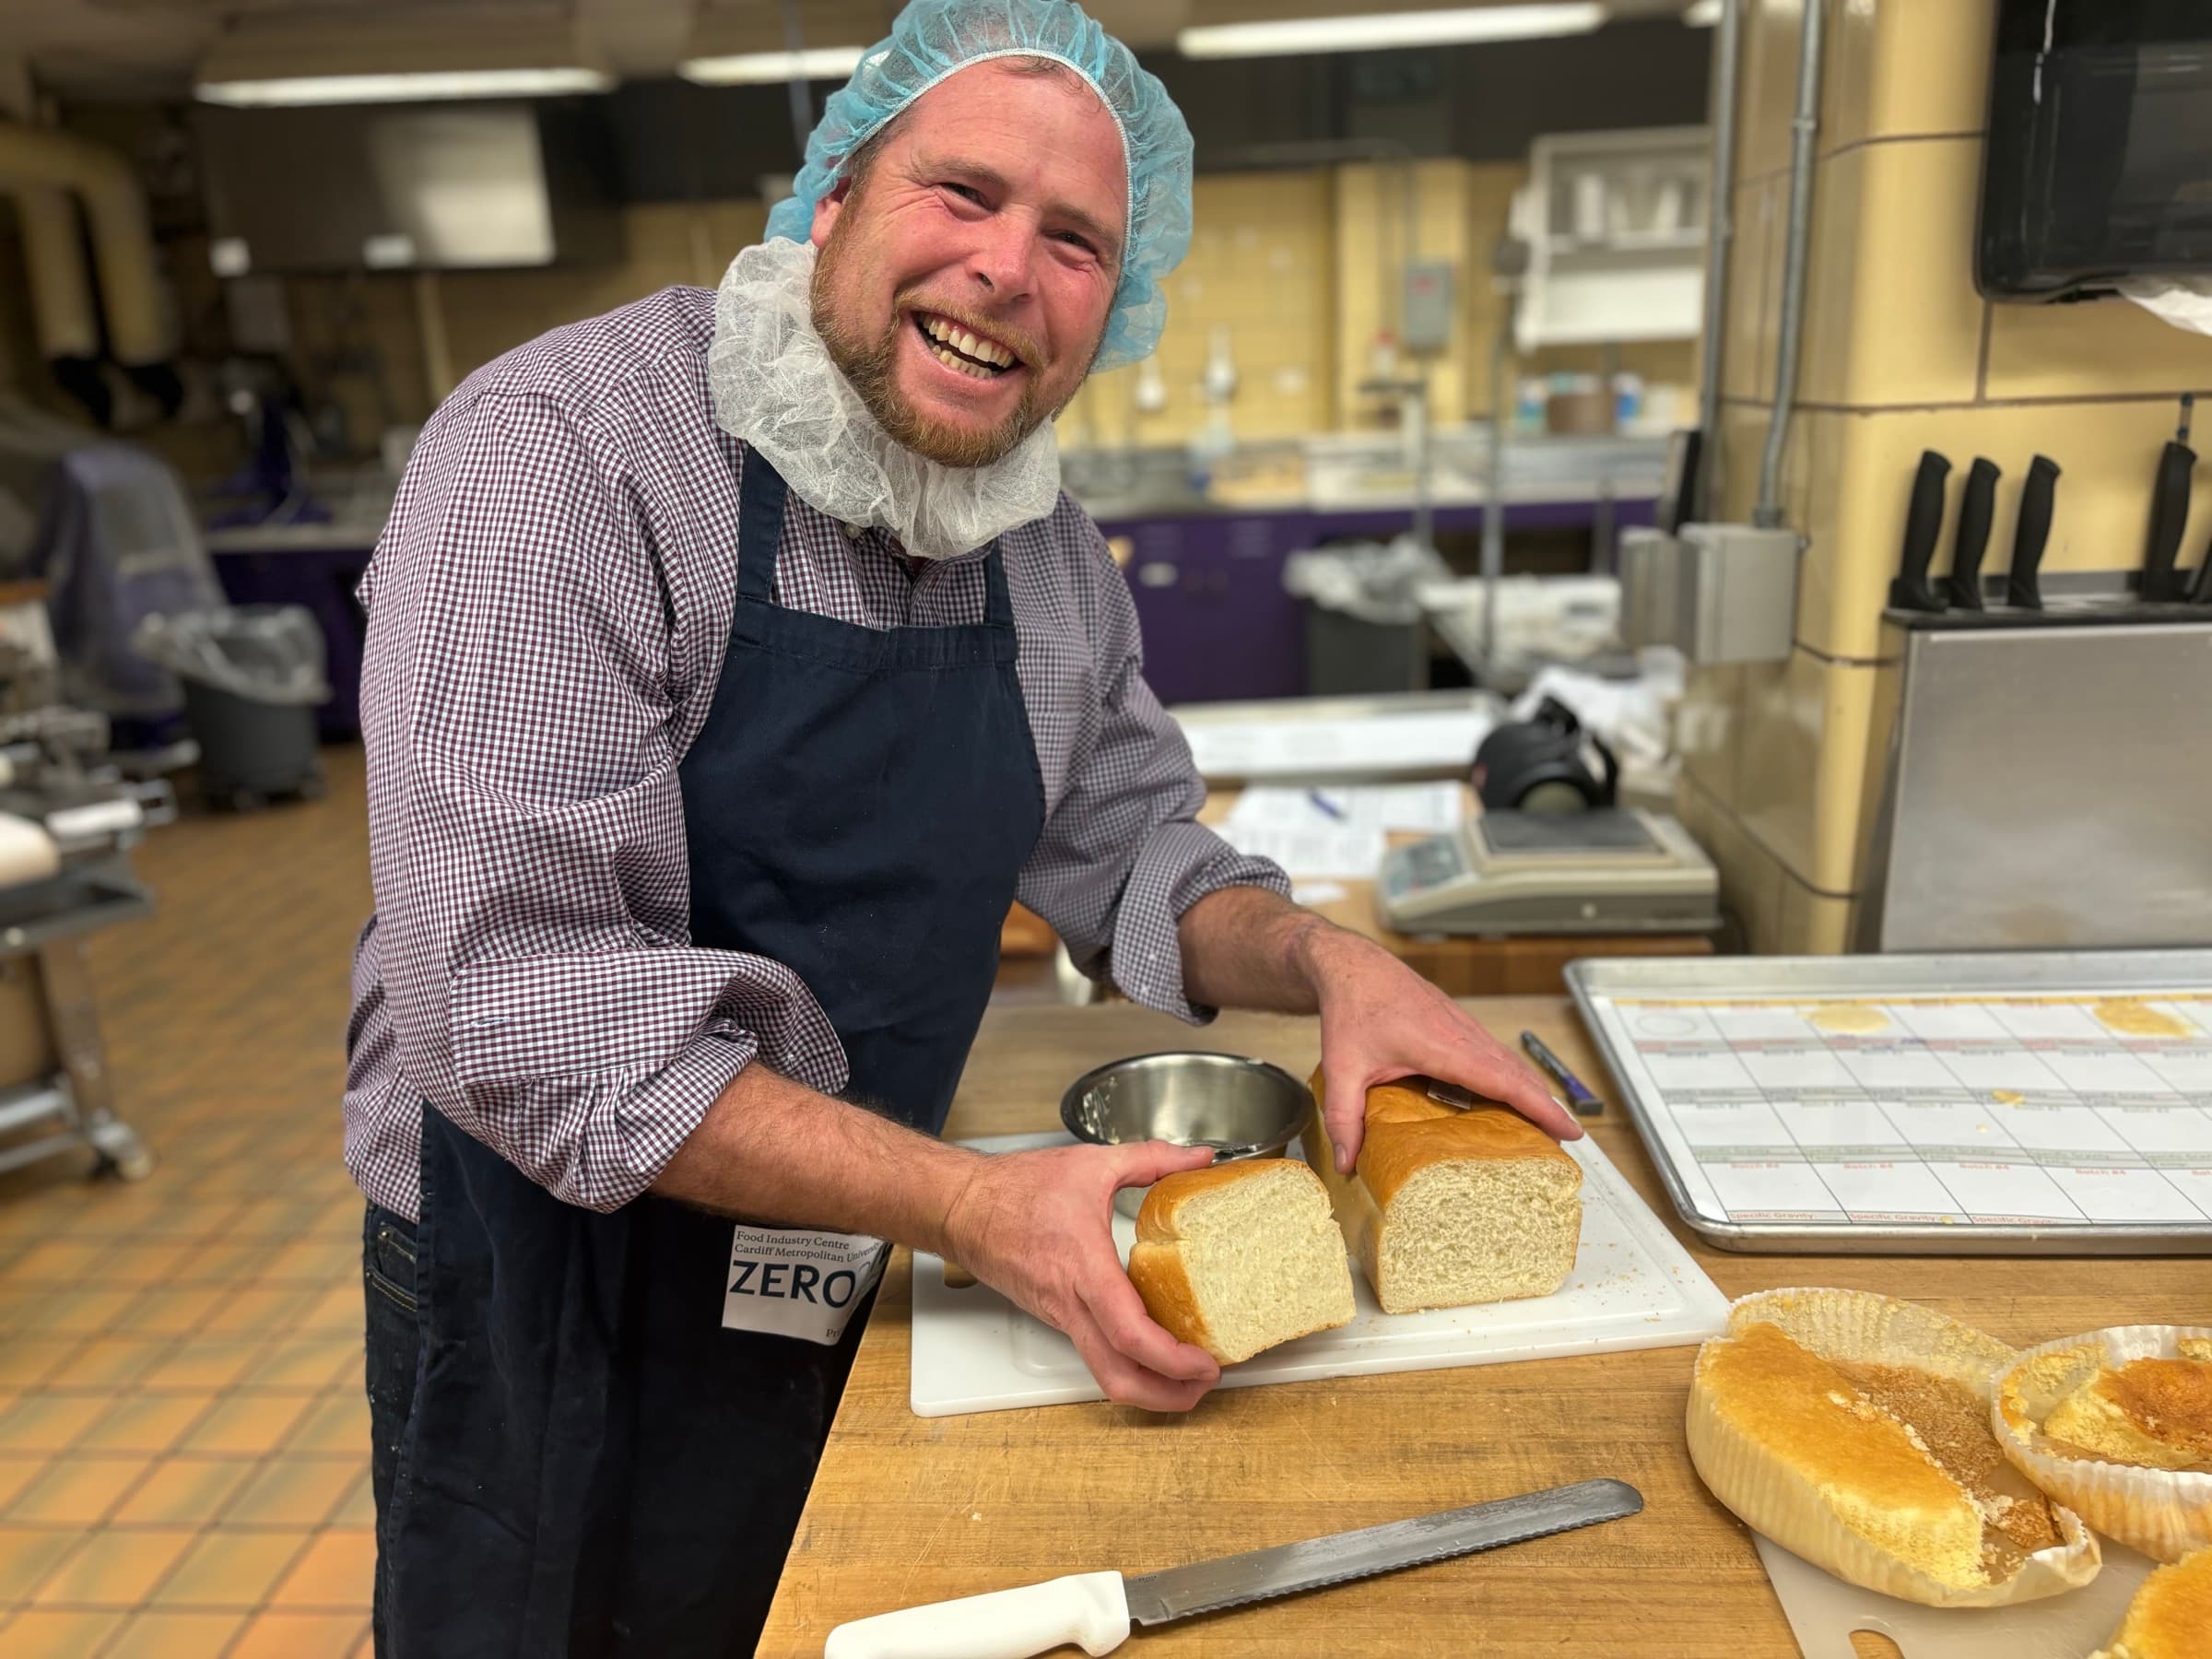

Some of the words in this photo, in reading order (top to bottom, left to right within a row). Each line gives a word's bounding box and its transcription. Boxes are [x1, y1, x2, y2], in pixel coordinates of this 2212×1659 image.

[737, 1230, 764, 1243] Food
[766, 1234, 812, 1247] Industry
[813, 1237, 850, 1250] Centre
[735, 1243, 774, 1255] Cardiff
[774, 1247, 844, 1263] Metropolitan
